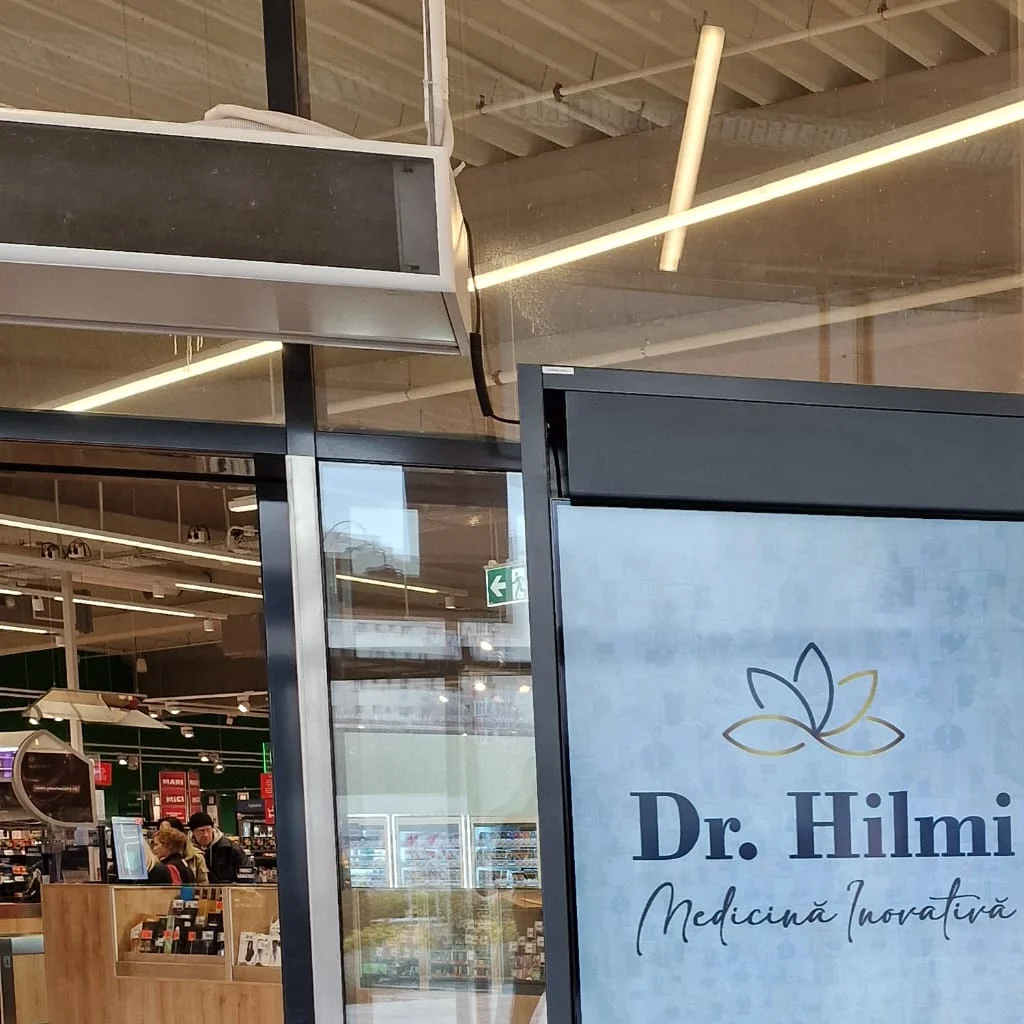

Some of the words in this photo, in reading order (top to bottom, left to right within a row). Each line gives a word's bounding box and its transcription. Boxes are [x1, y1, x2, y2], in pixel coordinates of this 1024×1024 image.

[630, 790, 758, 863] Dr.
[787, 790, 1015, 858] Hilmi
[636, 881, 838, 957] Medicină
[846, 877, 1018, 944] Inovativă
